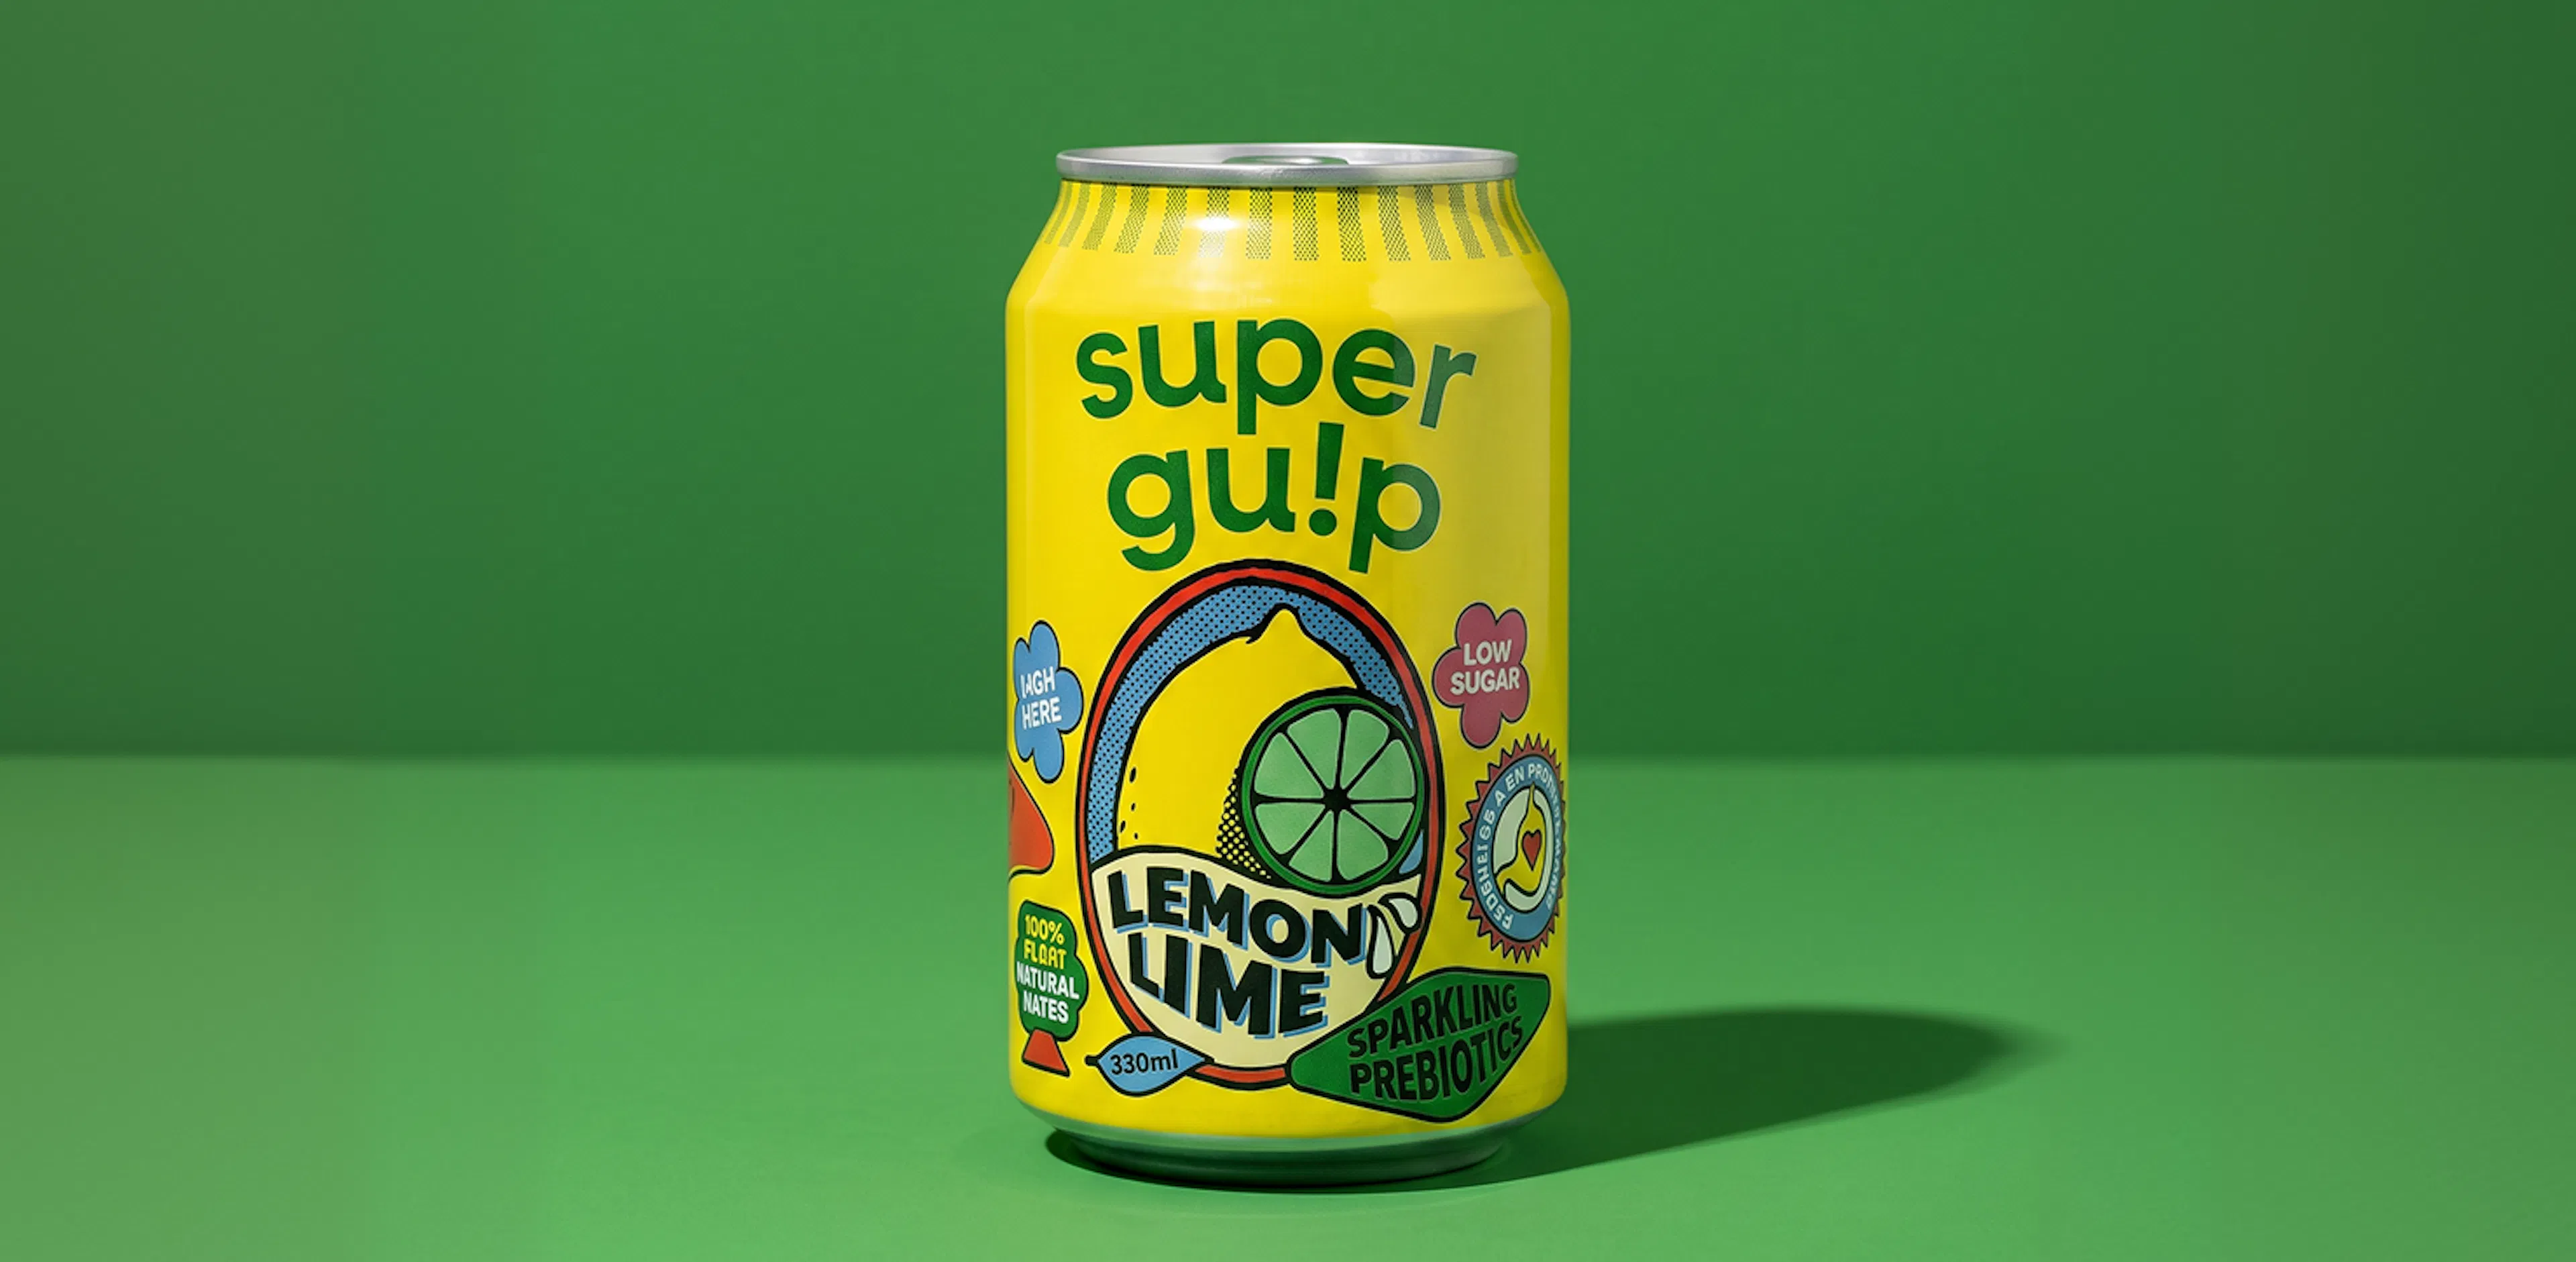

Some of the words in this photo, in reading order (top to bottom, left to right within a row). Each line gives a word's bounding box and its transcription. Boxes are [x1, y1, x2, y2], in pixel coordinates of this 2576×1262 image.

[1076, 318, 1477, 434] super
[1107, 421, 1441, 574] gu!p
[1464, 639, 1511, 666] LOW
[1450, 666, 1519, 695] SUGAR
[1022, 696, 1062, 729] HERE
[1505, 766, 1524, 792] EN
[1024, 915, 1065, 945] 100%
[1107, 866, 1367, 967] LEMON
[1016, 961, 1079, 1000] NATURAL
[1128, 933, 1329, 1039] LIME
[1023, 991, 1069, 1024] NATES
[1348, 984, 1517, 1057] SPARKLING
[1110, 1049, 1178, 1075] 330ml
[1350, 1016, 1523, 1102] PREBIOTICS
